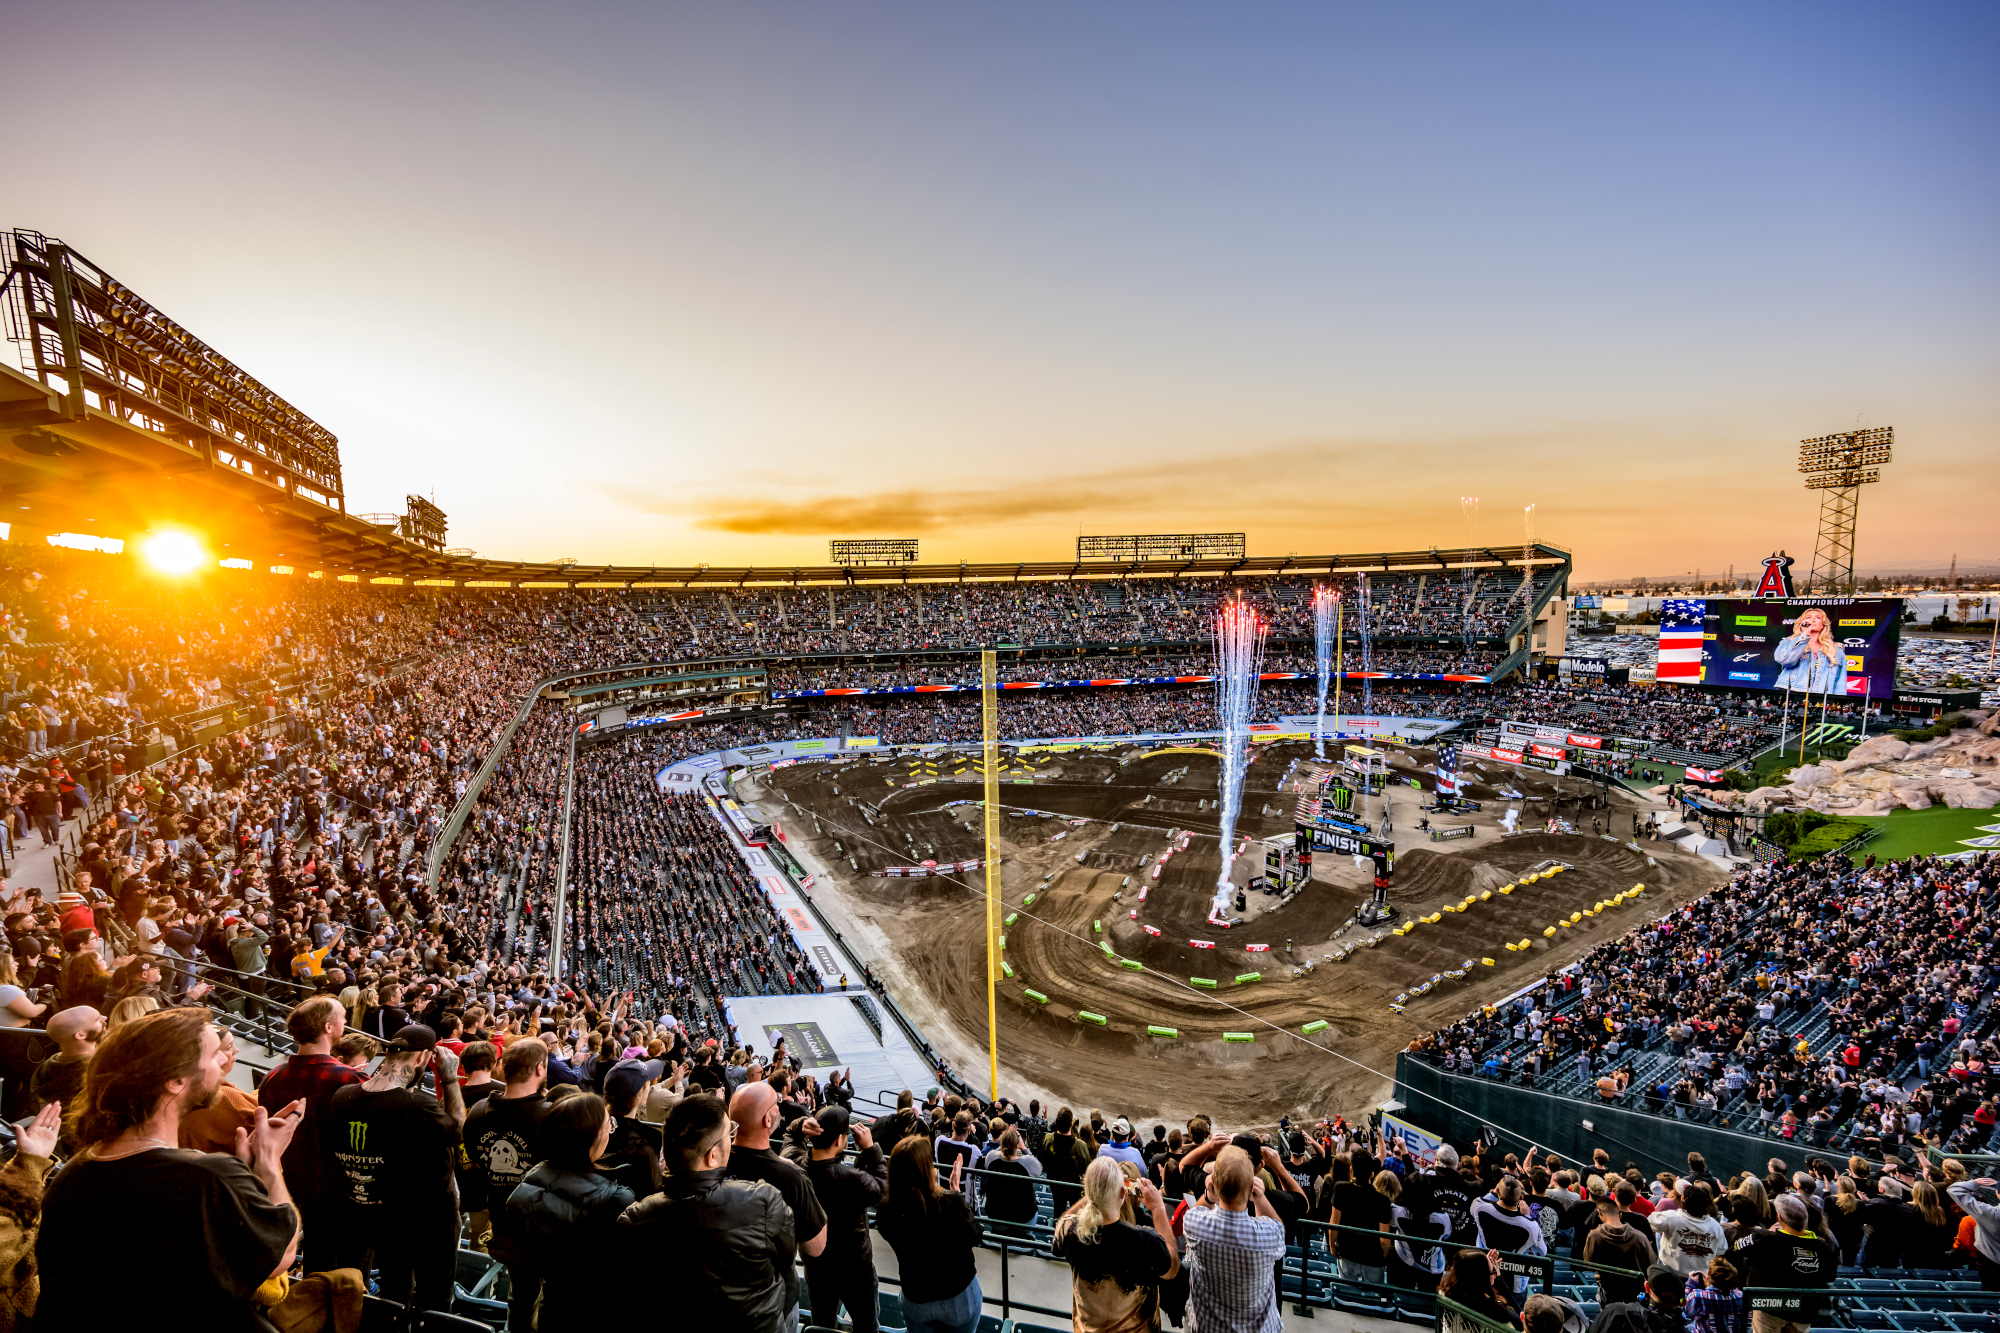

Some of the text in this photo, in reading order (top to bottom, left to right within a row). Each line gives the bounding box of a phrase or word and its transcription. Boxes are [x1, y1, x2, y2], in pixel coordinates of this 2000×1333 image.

[1571, 659, 1606, 674] Modelo
[1632, 669, 1655, 680] Modelo
[1899, 695, 1943, 705] TEAM STORE
[1374, 735, 1403, 743] SUZUKI
[1328, 810, 1356, 820] MONSTER
[1442, 828, 1467, 837] MONSTER
[1313, 829, 1361, 854] FINISH
[801, 1030, 824, 1059] MONSTER
[513, 1133, 529, 1151] HELL
[334, 1151, 385, 1164] MONSTER
[491, 1174, 506, 1182] MY
[1791, 1256, 1820, 1268] Finals
[1499, 1261, 1543, 1276] ECTION 435
[1751, 1298, 1801, 1308] SECTION 436
